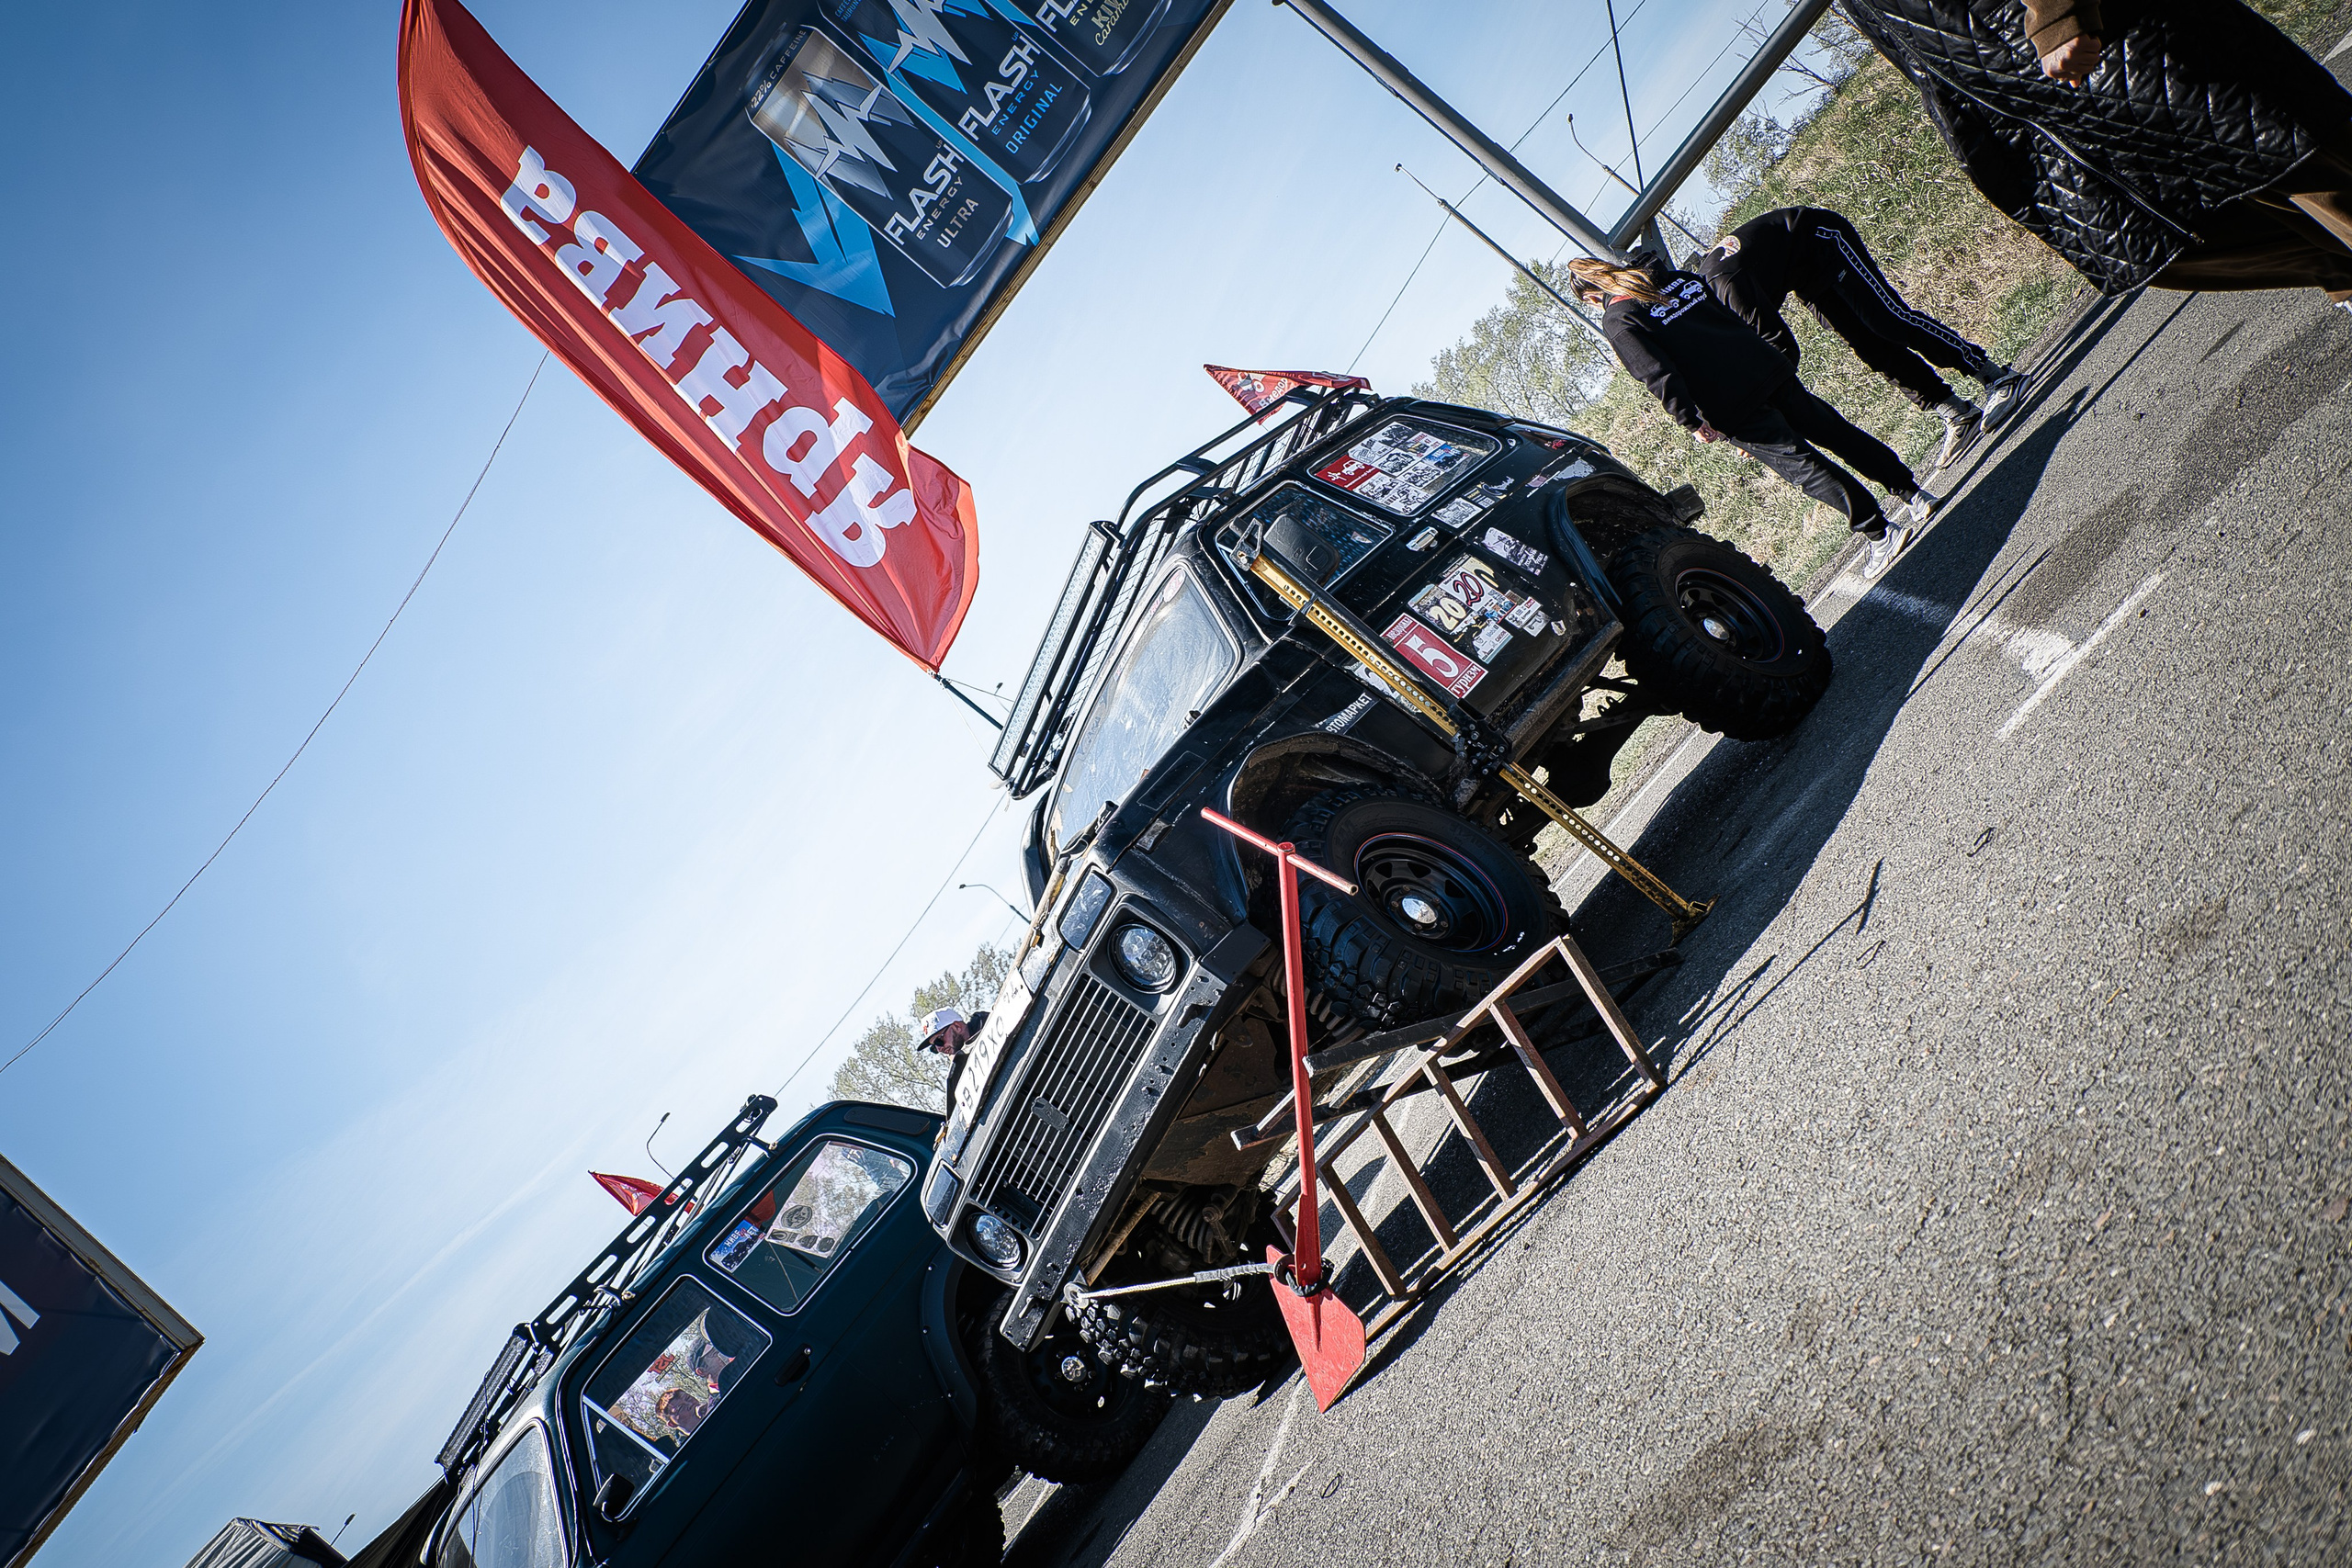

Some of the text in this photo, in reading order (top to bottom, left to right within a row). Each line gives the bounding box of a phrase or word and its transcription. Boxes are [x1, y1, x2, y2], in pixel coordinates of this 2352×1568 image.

[769, 28, 806, 79] CAFFEINE
[957, 39, 1041, 141] FLASH
[991, 69, 1040, 135] ENERGY
[1005, 82, 1062, 154] ORIGINAL
[883, 144, 965, 244] FLASH
[916, 175, 964, 239] ENERGY
[936, 197, 979, 248] ULTRA
[1406, 632, 1453, 677] 5
